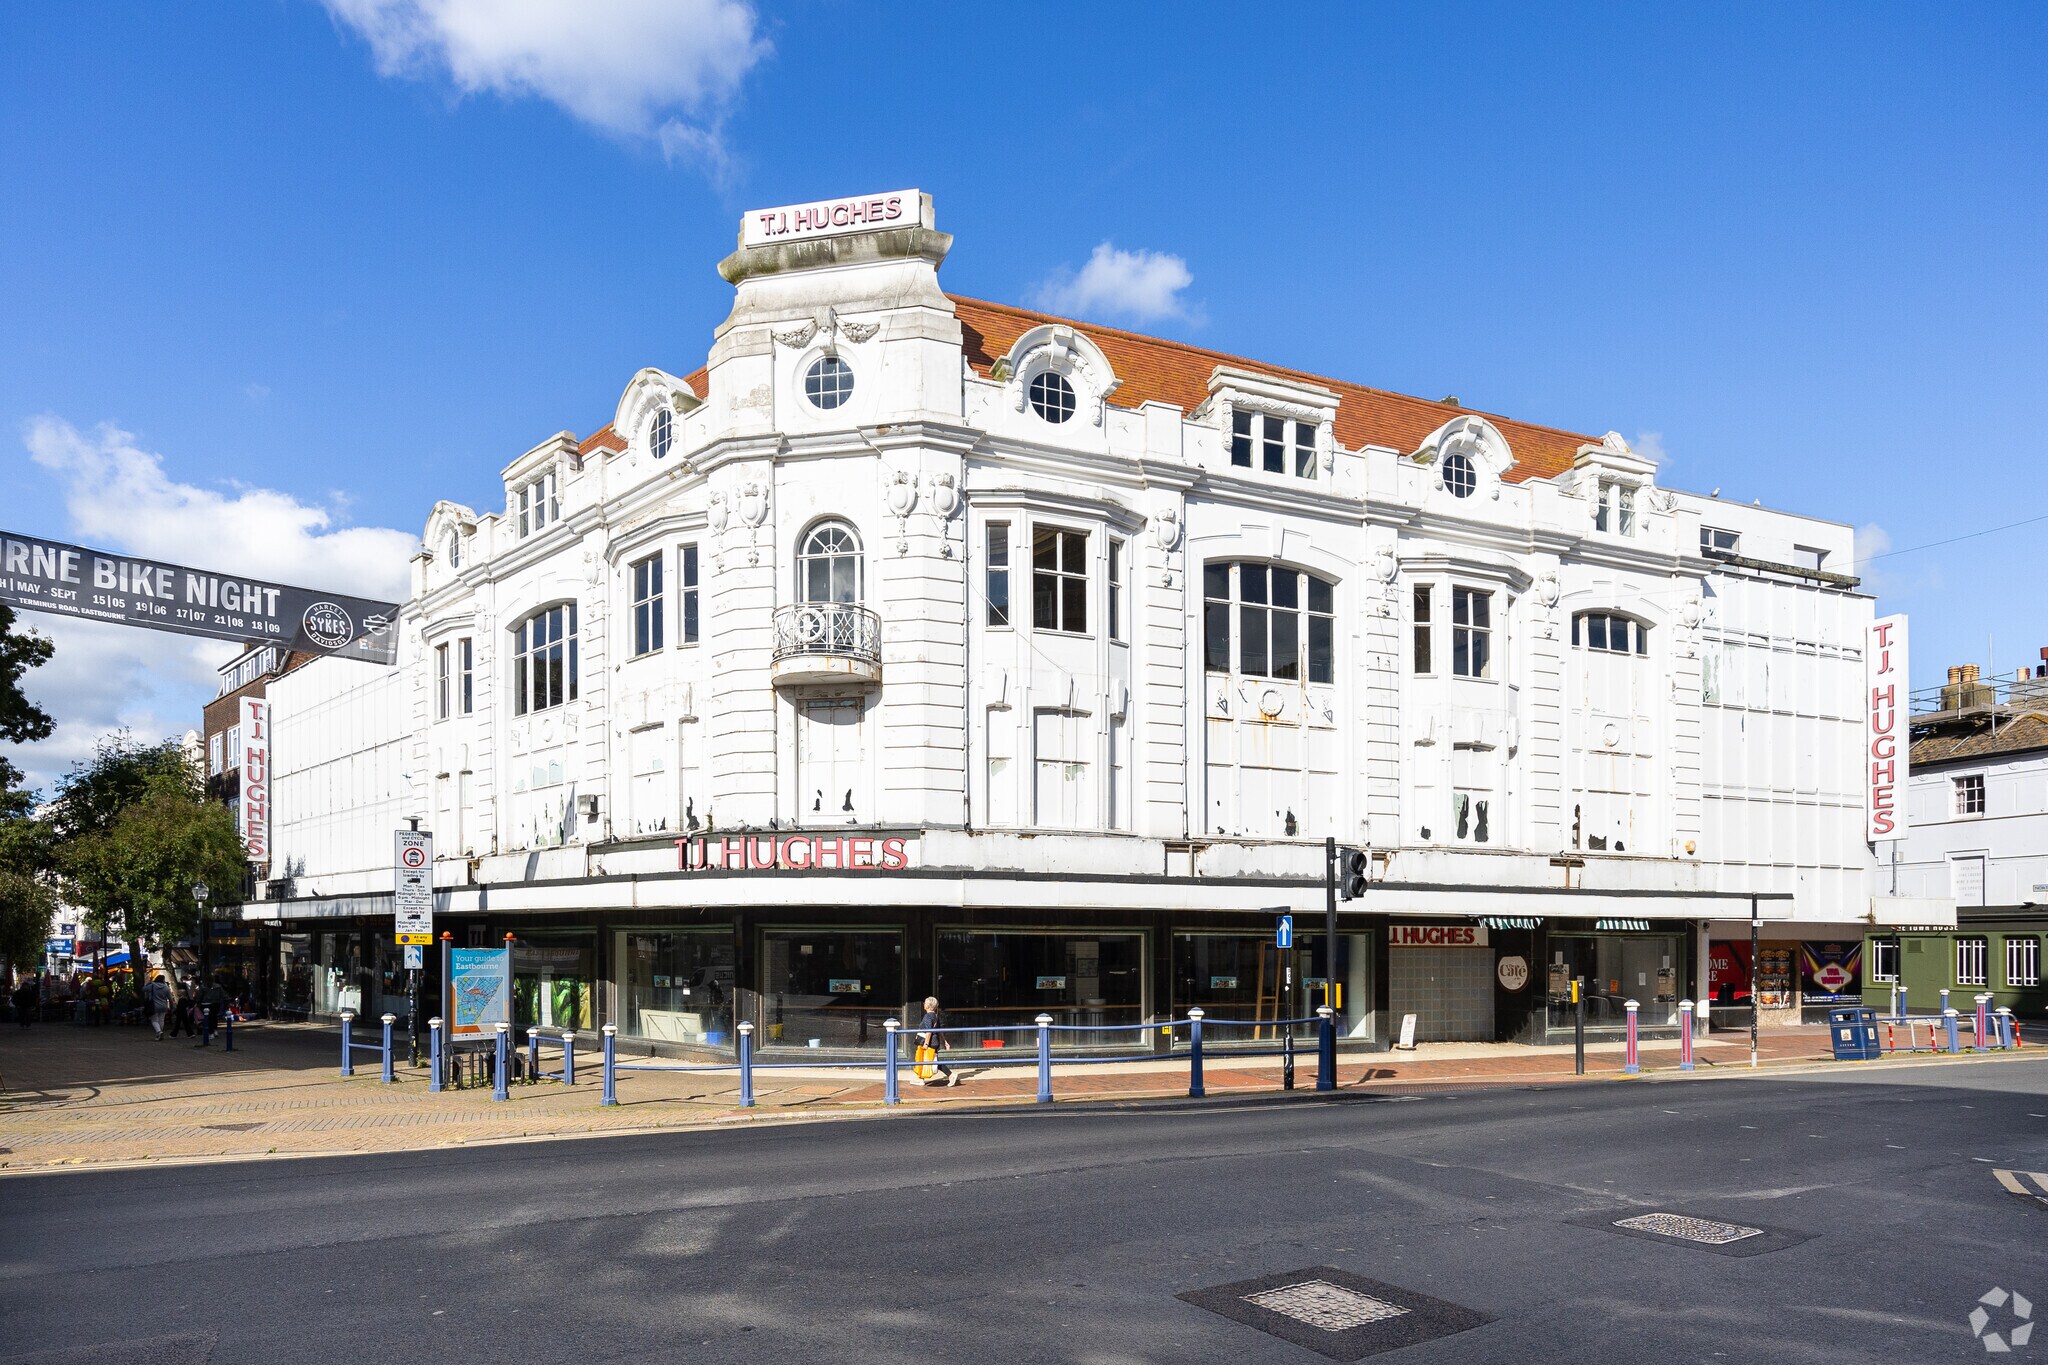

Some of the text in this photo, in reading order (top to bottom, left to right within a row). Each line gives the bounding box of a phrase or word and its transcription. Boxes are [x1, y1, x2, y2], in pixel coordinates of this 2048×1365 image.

[760, 197, 902, 236] T.J. HUGHES
[0, 538, 280, 617] RNE BIKE NIGHT
[17, 580, 41, 594] MAY
[50, 587, 77, 600] SEPT
[19, 597, 126, 620] TERMINUS ROAD, EASTBOURNE
[313, 604, 343, 616] HARLEY
[310, 615, 346, 635] SYKES
[311, 633, 347, 646] DAVIDSON
[1871, 684, 1896, 835] HUGHES
[246, 747, 265, 857] HUGHES
[721, 835, 909, 871] HUGHES
[1402, 927, 1476, 944] HUGHES
[1500, 963, 1527, 978] Café
